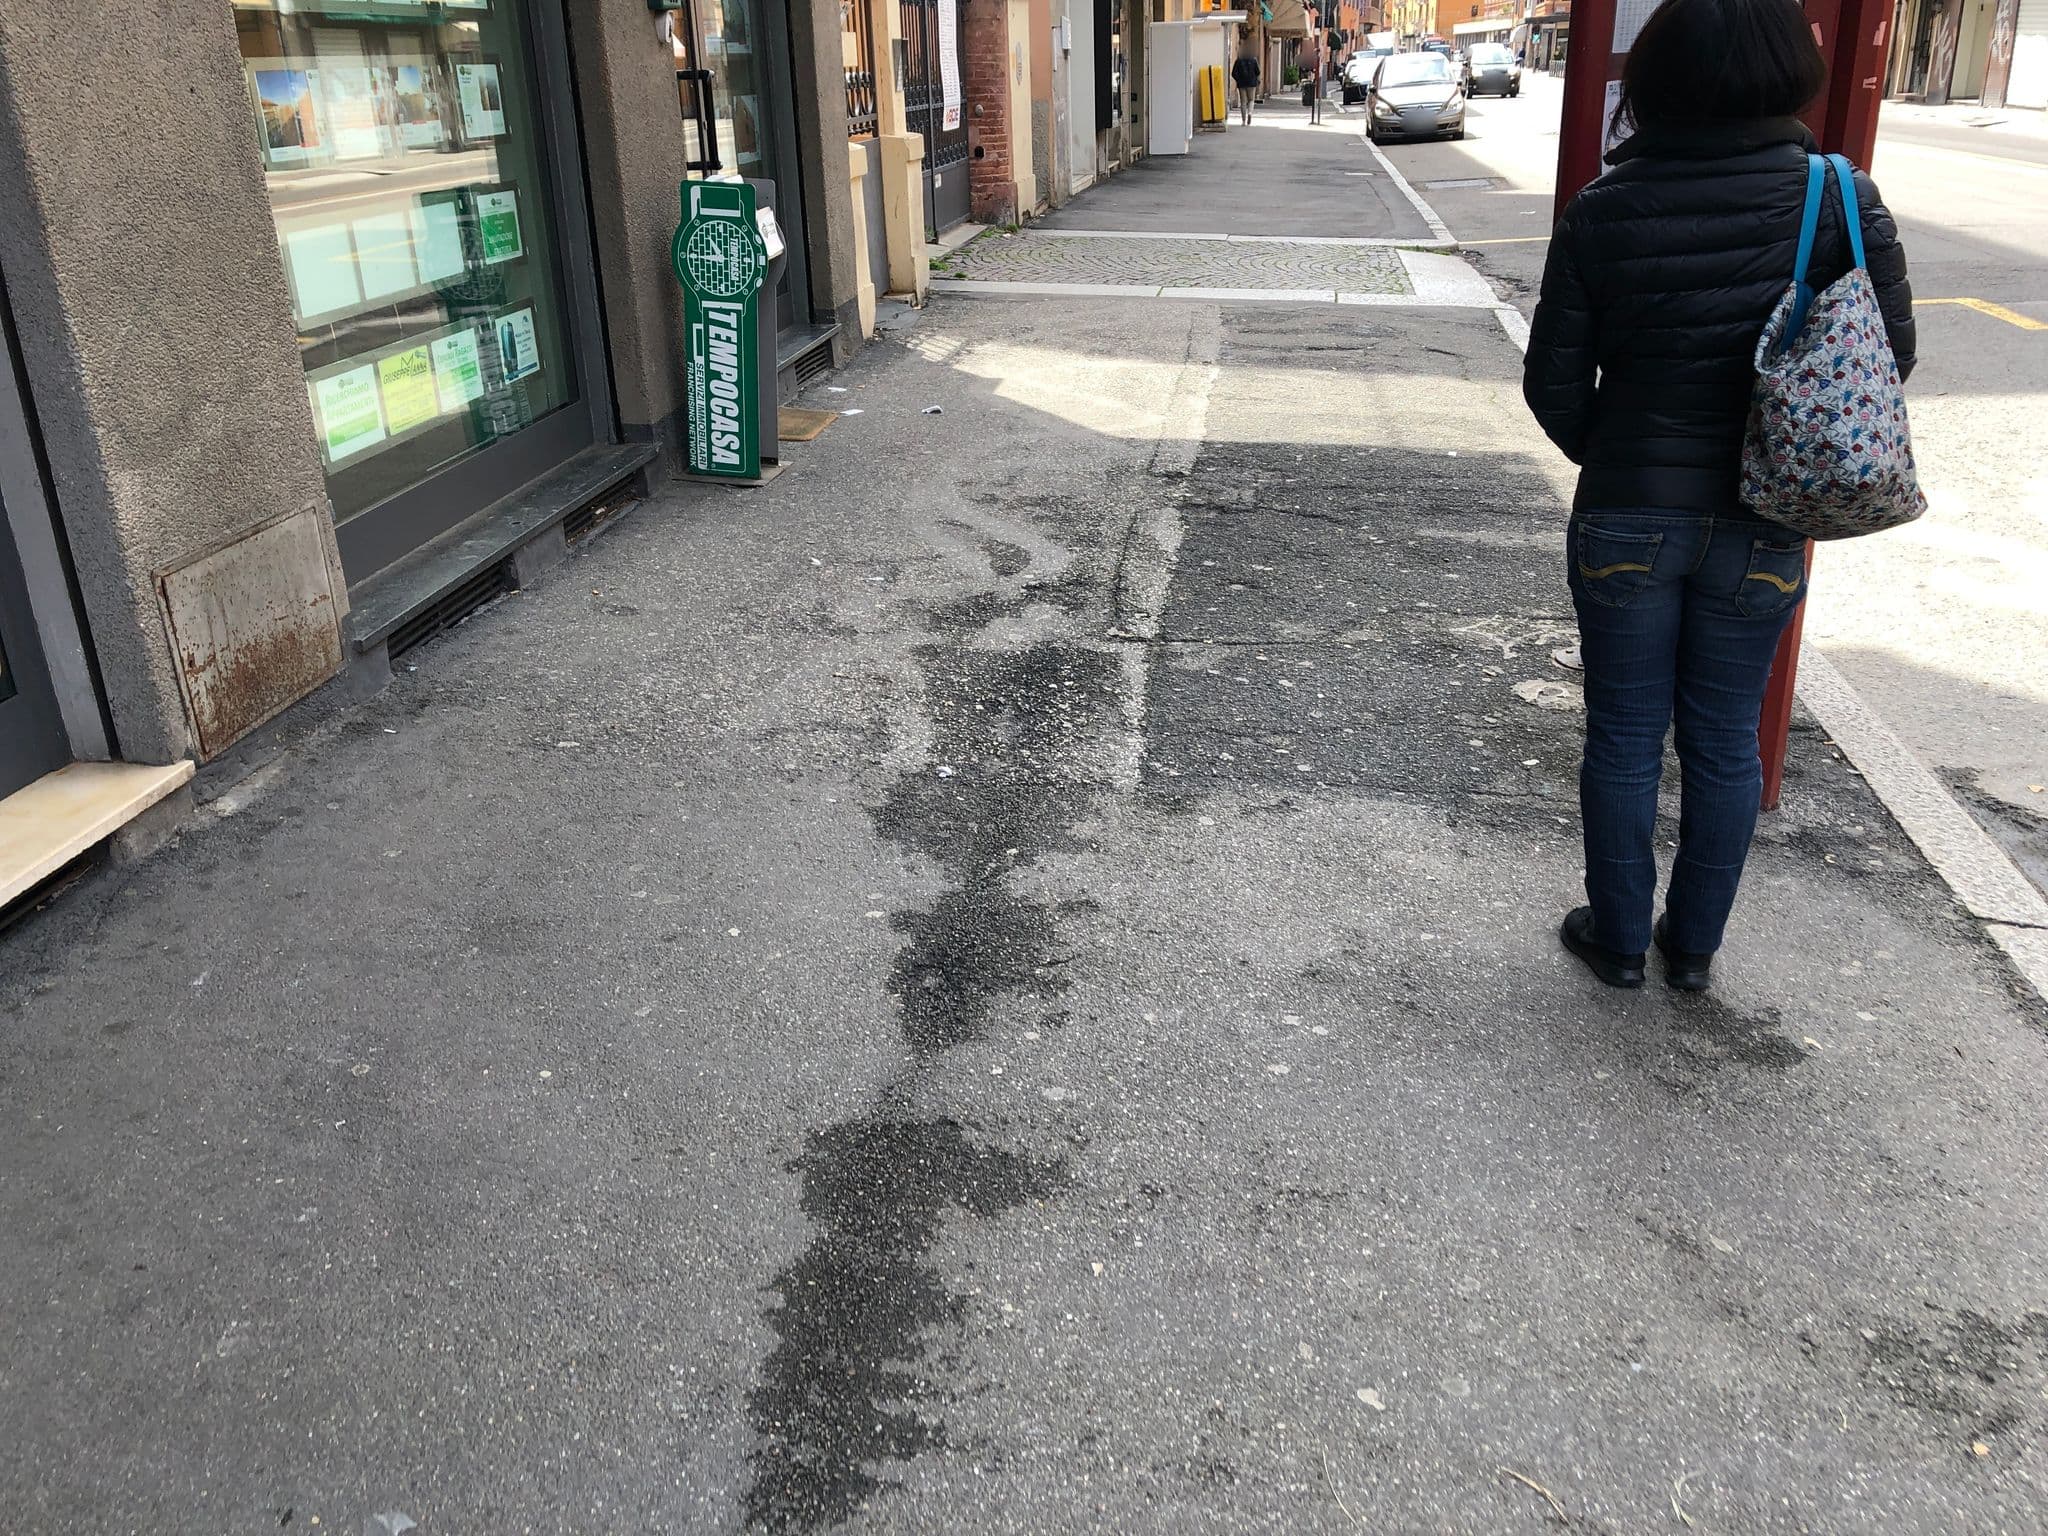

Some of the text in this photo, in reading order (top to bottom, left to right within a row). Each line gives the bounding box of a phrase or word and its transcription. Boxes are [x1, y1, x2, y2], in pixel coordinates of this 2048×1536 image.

[730, 237, 740, 281] TEMPOCASA
[687, 361, 697, 467] FRANCHISING NETWORK
[696, 362, 706, 466] SERVIZI IMMOBILIARI
[708, 310, 741, 465] TEMPOCASA
